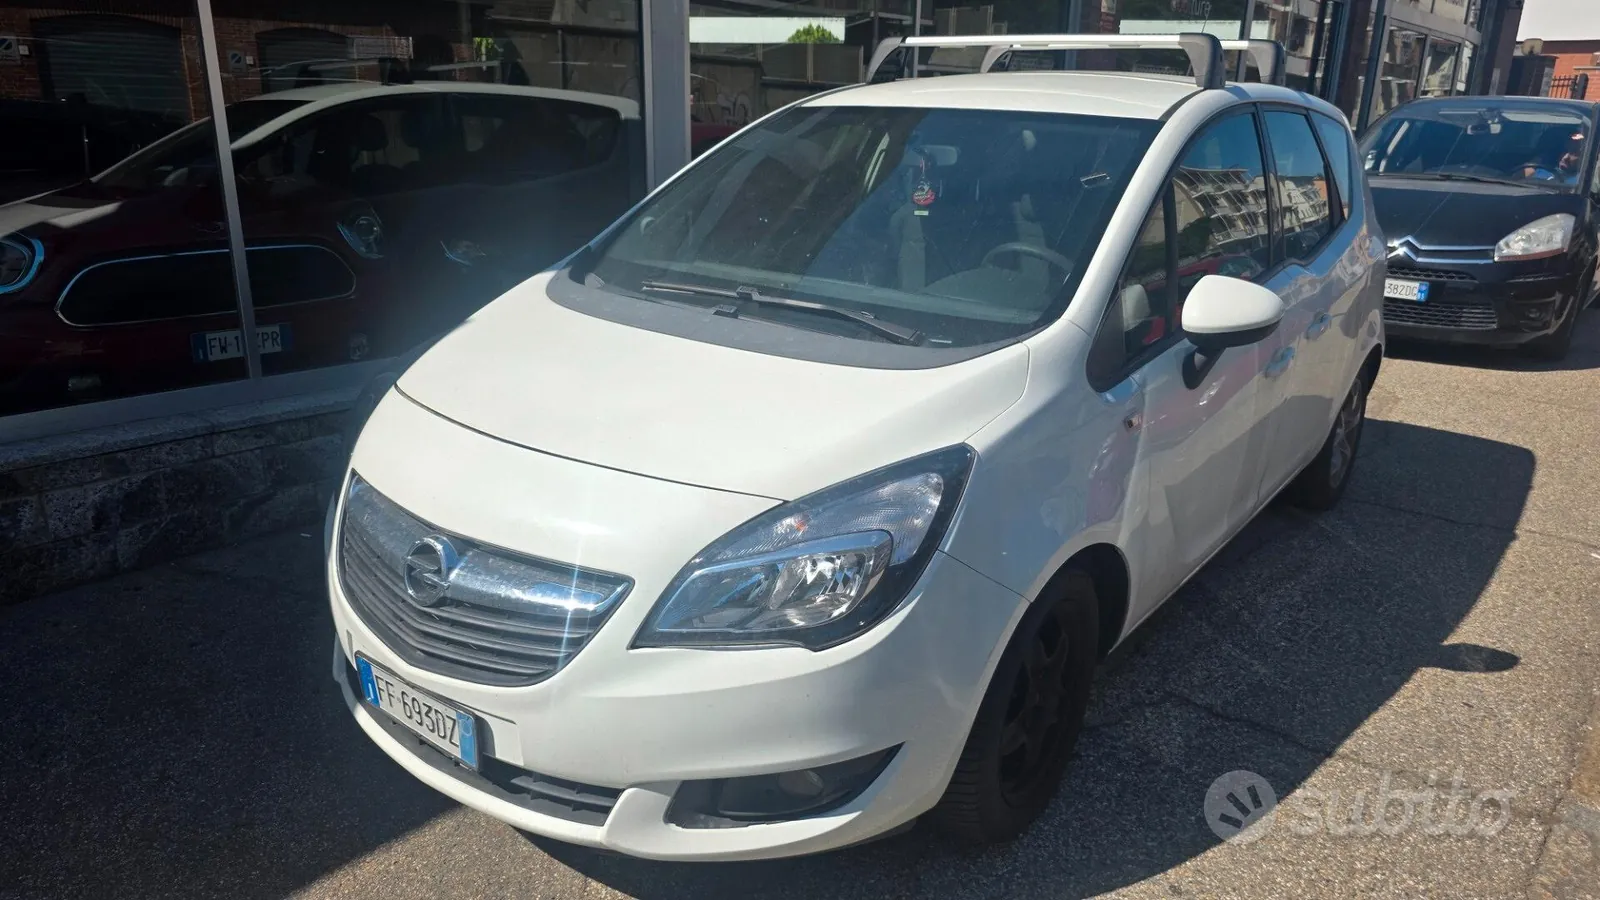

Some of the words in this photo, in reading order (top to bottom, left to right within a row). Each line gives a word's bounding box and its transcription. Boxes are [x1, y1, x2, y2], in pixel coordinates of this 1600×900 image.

[208, 336, 228, 356] FW
[235, 331, 280, 353] 1PR
[375, 674, 394, 708] FF
[401, 690, 460, 748] 693DZ
